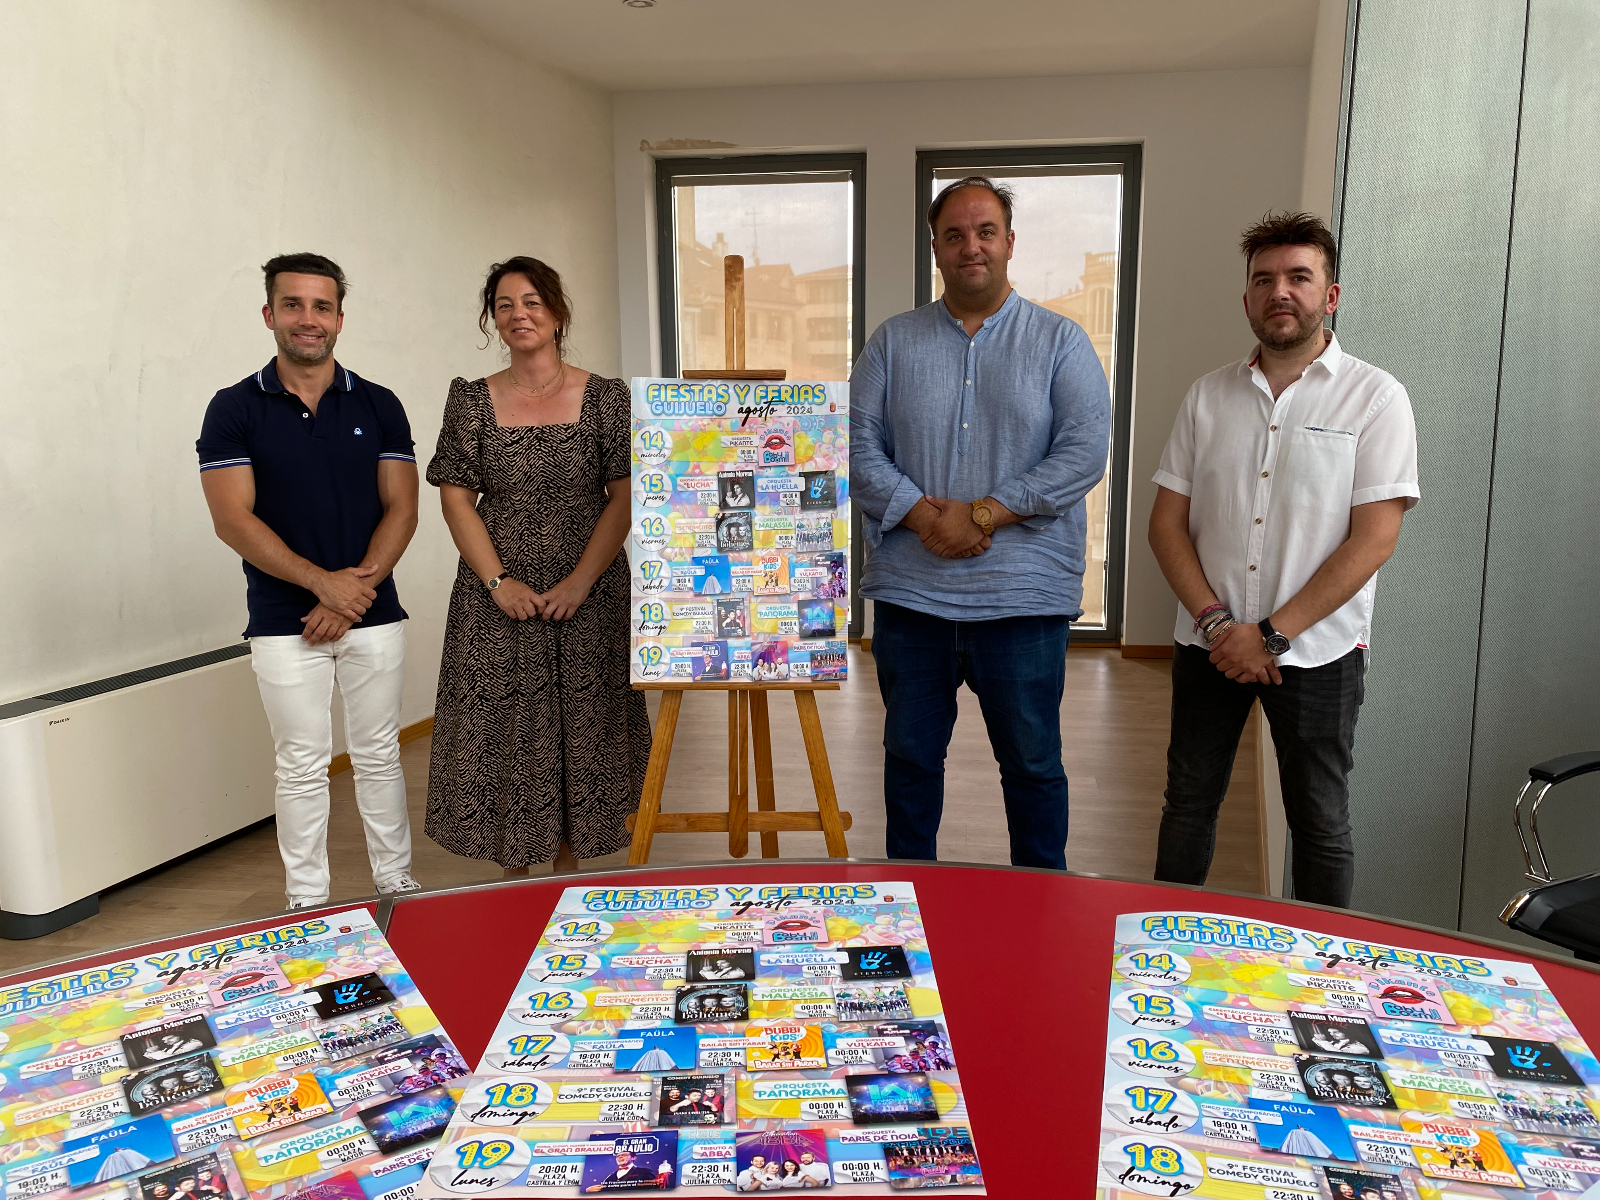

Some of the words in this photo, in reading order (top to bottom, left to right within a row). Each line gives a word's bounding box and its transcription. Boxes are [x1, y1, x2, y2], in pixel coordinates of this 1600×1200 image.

[648, 384, 730, 403] FIESTAS
[734, 384, 751, 402] Y
[754, 385, 827, 405] FERIAS
[651, 400, 727, 416] GUIJUELO
[737, 397, 784, 427] agosto
[786, 406, 813, 415] 2024
[640, 430, 666, 450] 14
[640, 473, 665, 493] 15
[771, 482, 798, 490] HUELLA
[643, 493, 666, 506] jueves
[641, 517, 665, 537] 16
[640, 560, 663, 580] 17
[642, 578, 665, 593] sábado
[640, 603, 664, 623] 18
[757, 610, 798, 618] PANORAMA
[638, 621, 667, 636] domingo
[639, 646, 663, 666] 19
[642, 663, 661, 677] lunes
[583, 888, 719, 903] FIESTAS
[725, 887, 752, 900] Y
[758, 885, 876, 900] FERIAS
[586, 899, 712, 911] GUIJUELO
[730, 894, 808, 915] agosto
[560, 922, 601, 936] 14
[1142, 916, 1298, 944] FIESTAS
[1301, 932, 1334, 951] Y
[1342, 940, 1492, 977] FERIAS
[1149, 929, 1293, 952] GUIJUELO
[0, 962, 139, 1006] ESTAS
[144, 952, 179, 970] Y
[188, 919, 330, 963] FERIAS
[156, 947, 240, 986] agosto
[257, 937, 309, 955] 2024
[545, 954, 587, 971] 15
[767, 957, 785, 965] LA
[1131, 952, 1176, 971] 14
[1315, 950, 1408, 970] agosto
[1413, 966, 1470, 981] 2024
[541, 971, 586, 983] jueves
[761, 991, 829, 999] MALASSIA
[1306, 981, 1356, 992] PIKANTE
[0, 976, 132, 1016] UIJUELO
[528, 991, 574, 1011] 16
[1128, 992, 1176, 1017] 15
[224, 1016, 245, 1027] LA
[249, 999, 308, 1021] HUELLA
[521, 1010, 573, 1019] viernes
[1132, 1014, 1180, 1026] jueves
[122, 1026, 162, 1042] Antonio
[163, 1014, 203, 1030] Moreno
[231, 1035, 311, 1063] MALASSIA
[508, 1034, 557, 1056] 17
[1127, 1037, 1180, 1063] 16
[1389, 1035, 1410, 1045] LA
[1413, 1037, 1478, 1052] HUELLA
[81, 1059, 109, 1072] 22:30
[282, 1051, 309, 1062] 00:00
[501, 1055, 550, 1069] sábado
[347, 1065, 402, 1085] VULKANO
[1128, 1060, 1184, 1073] viernes
[758, 1087, 847, 1098] PANORAMA
[773, 1082, 830, 1090] ORQUESTA
[1401, 1078, 1487, 1096] MALASSIA
[485, 1082, 538, 1109] 18
[1125, 1085, 1178, 1113] 17
[79, 1104, 109, 1118] 22:30
[637, 1103, 646, 1111] H.
[808, 1102, 835, 1110] 00:00
[838, 1101, 847, 1109] H.
[470, 1104, 539, 1126] domingo
[1129, 1111, 1183, 1132] sábado
[187, 1126, 217, 1141] 22:30
[1212, 1120, 1238, 1130] 19:00
[263, 1124, 366, 1164] PANORAMA
[574, 1145, 614, 1153] BRAULIO
[615, 1144, 654, 1154] BRAULIO
[456, 1138, 515, 1169] 19
[700, 1150, 732, 1158] ABBA
[1123, 1142, 1184, 1176] 18
[538, 1165, 568, 1174] 20:00
[570, 1164, 580, 1173] H.
[691, 1164, 719, 1173] 22:30
[722, 1164, 732, 1173] H.
[842, 1162, 870, 1171] 00:00
[873, 1161, 884, 1170] H.
[1242, 1165, 1298, 1179] FESTIVAL
[450, 1169, 500, 1188] lunes
[1118, 1166, 1195, 1197] domingo
[1208, 1167, 1259, 1181] COMEDY
[1262, 1174, 1320, 1189] GUIJUELO
